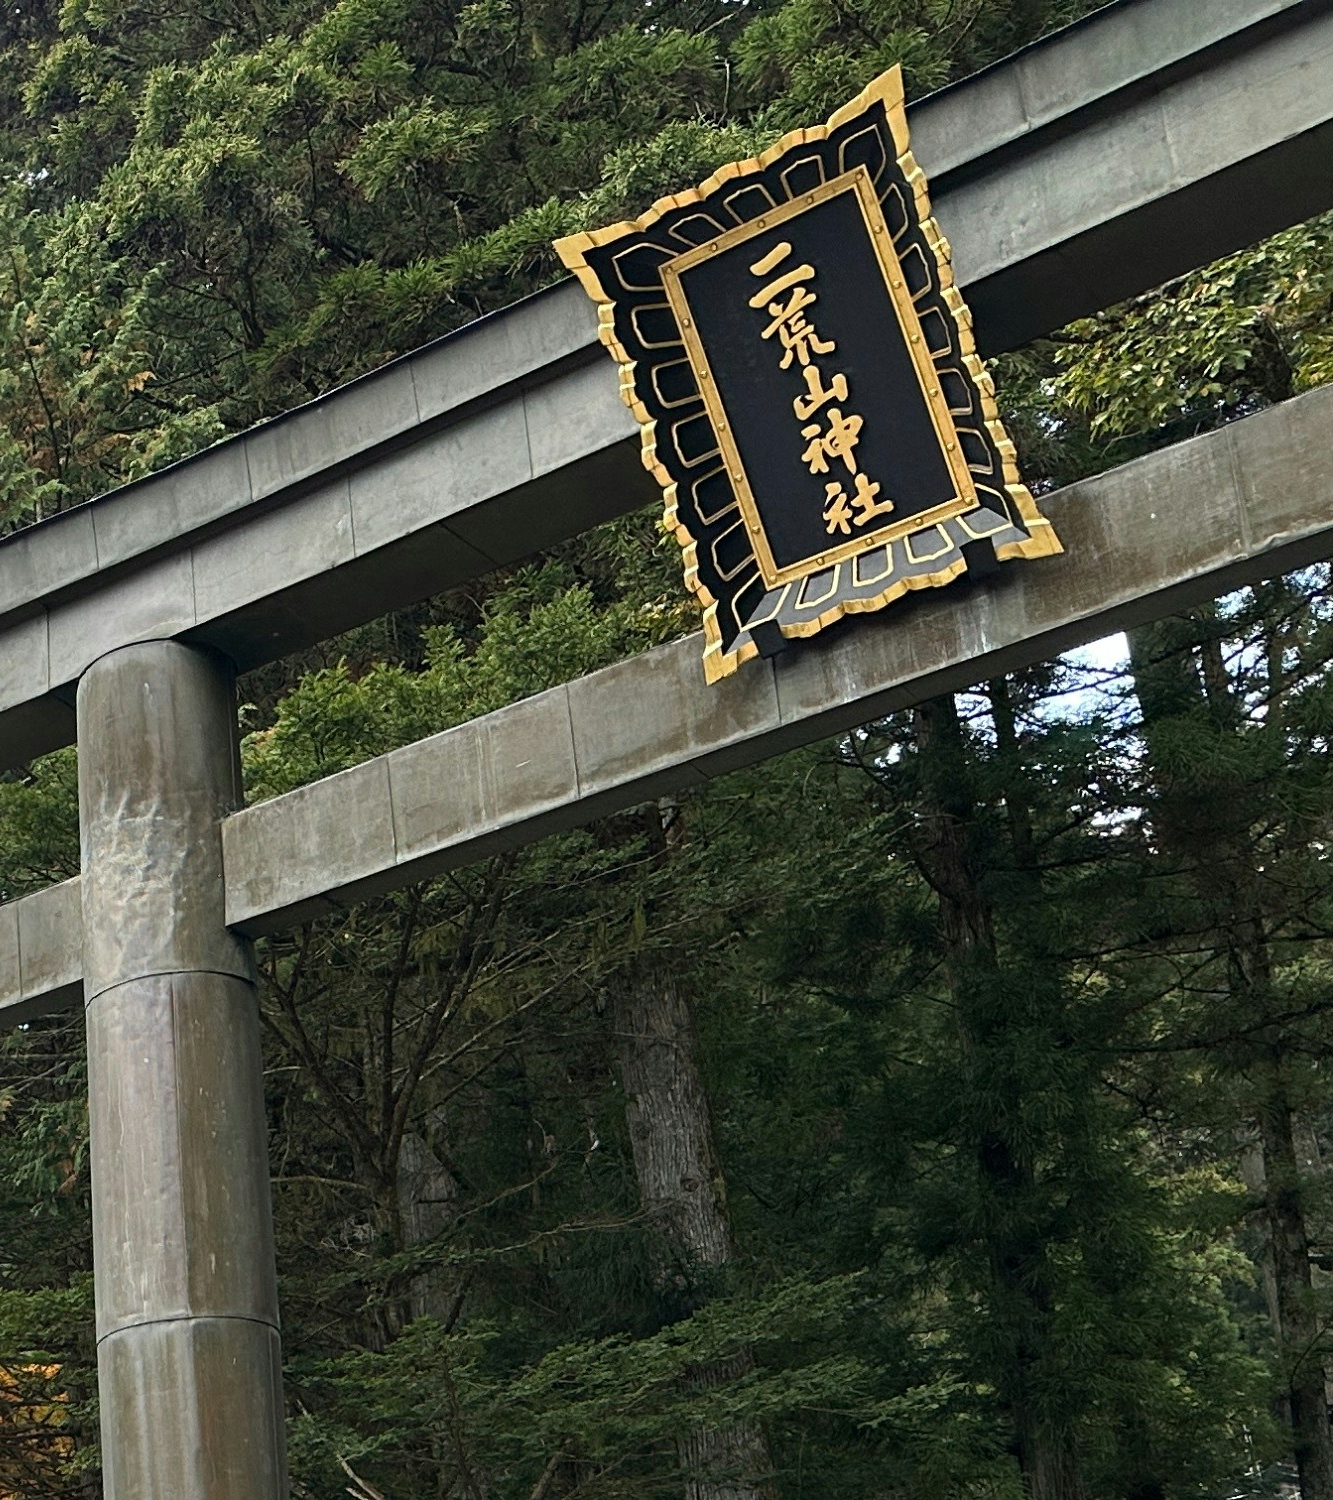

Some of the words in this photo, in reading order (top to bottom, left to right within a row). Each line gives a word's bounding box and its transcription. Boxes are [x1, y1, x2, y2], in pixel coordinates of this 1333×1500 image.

[749, 242, 893, 534] 二荒山神社
